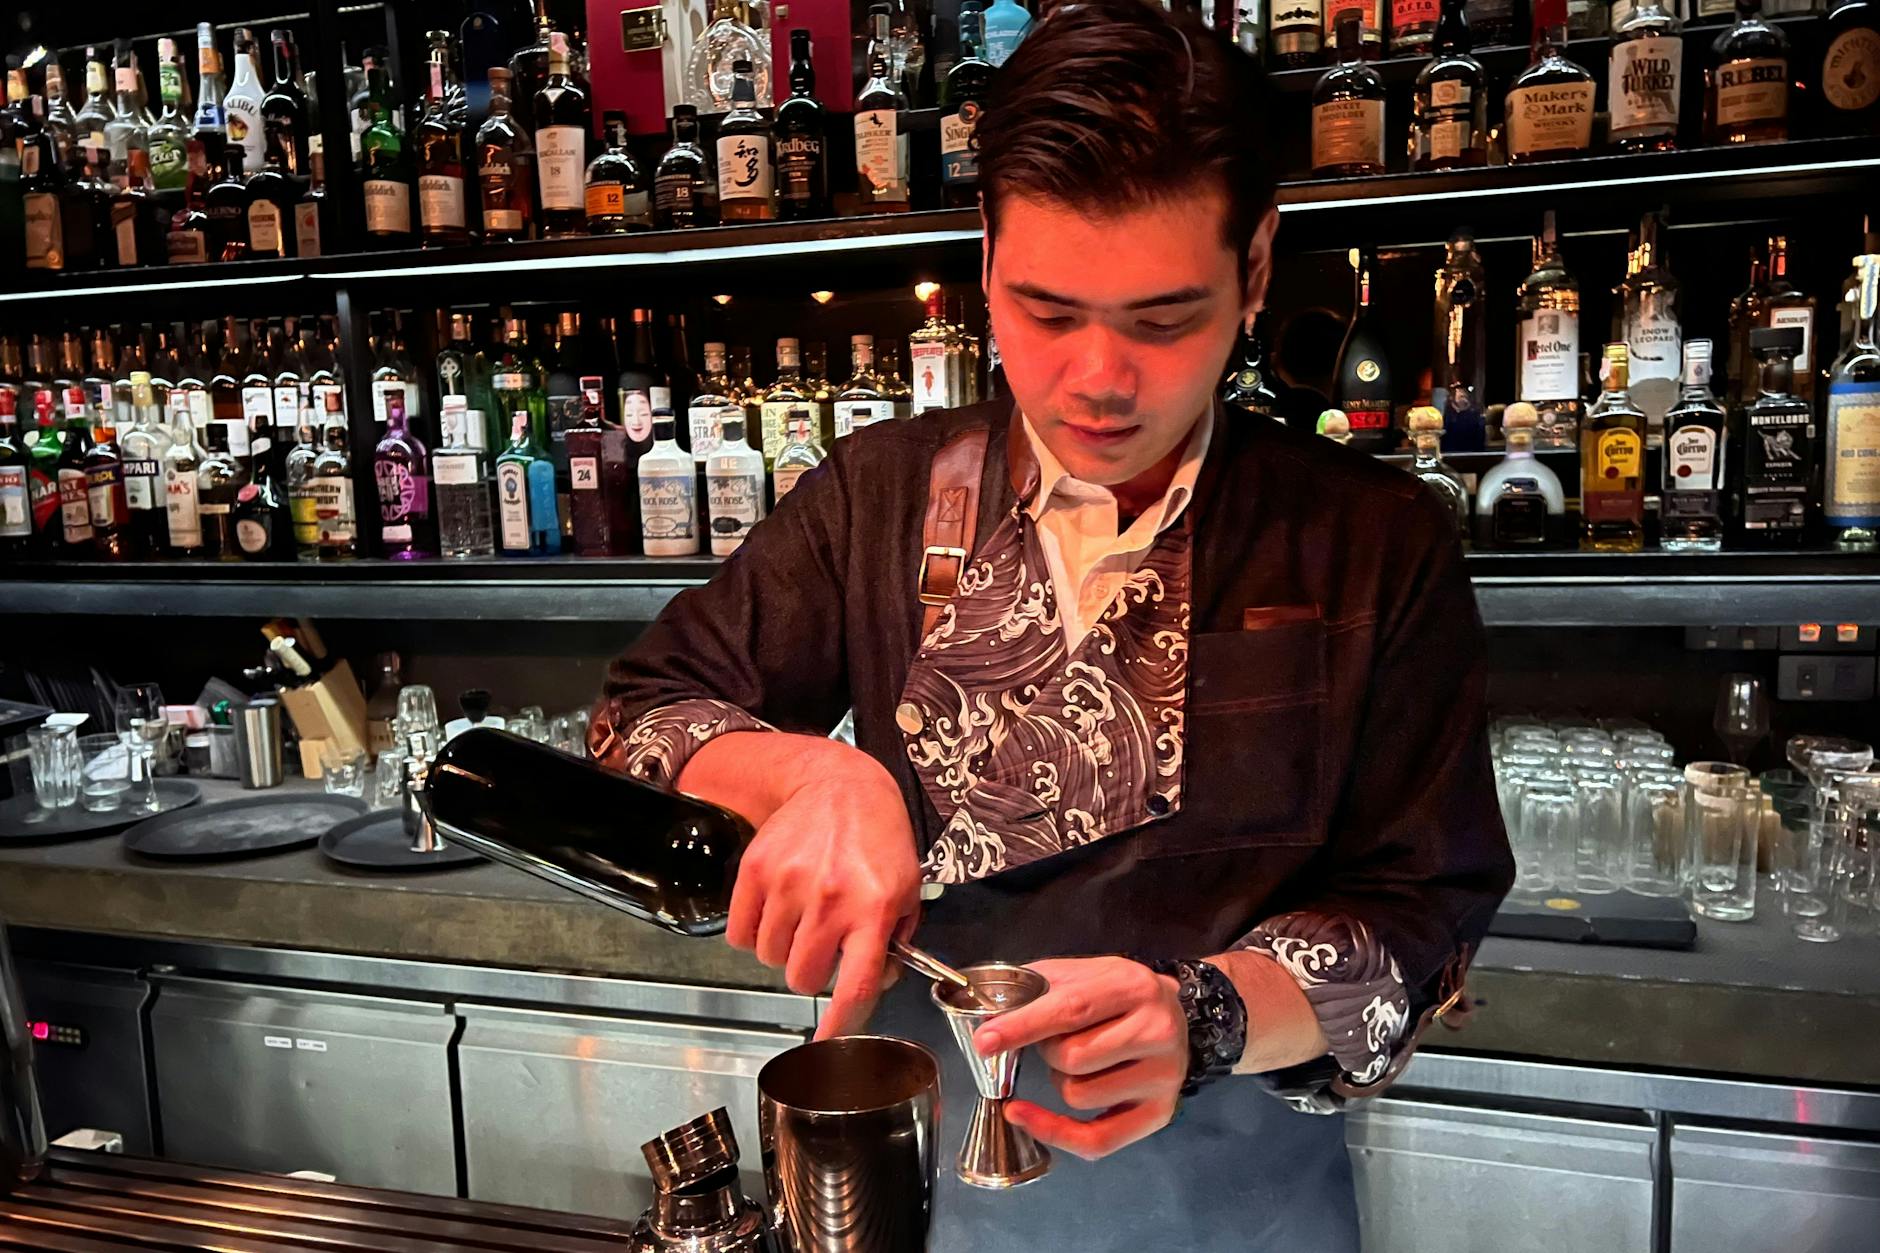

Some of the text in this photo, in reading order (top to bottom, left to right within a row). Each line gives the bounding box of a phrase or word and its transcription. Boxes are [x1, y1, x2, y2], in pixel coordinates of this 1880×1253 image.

[1632, 58, 1671, 75] WILD
[1621, 74, 1676, 95] TURKEY
[1524, 90, 1588, 104] Maker's
[1542, 103, 1586, 116] Mark
[734, 140, 759, 187] 知多
[948, 162, 960, 177] 12
[608, 193, 619, 203] 12
[676, 187, 689, 198] 18
[1553, 342, 1571, 352] One
[577, 469, 591, 481] 24
